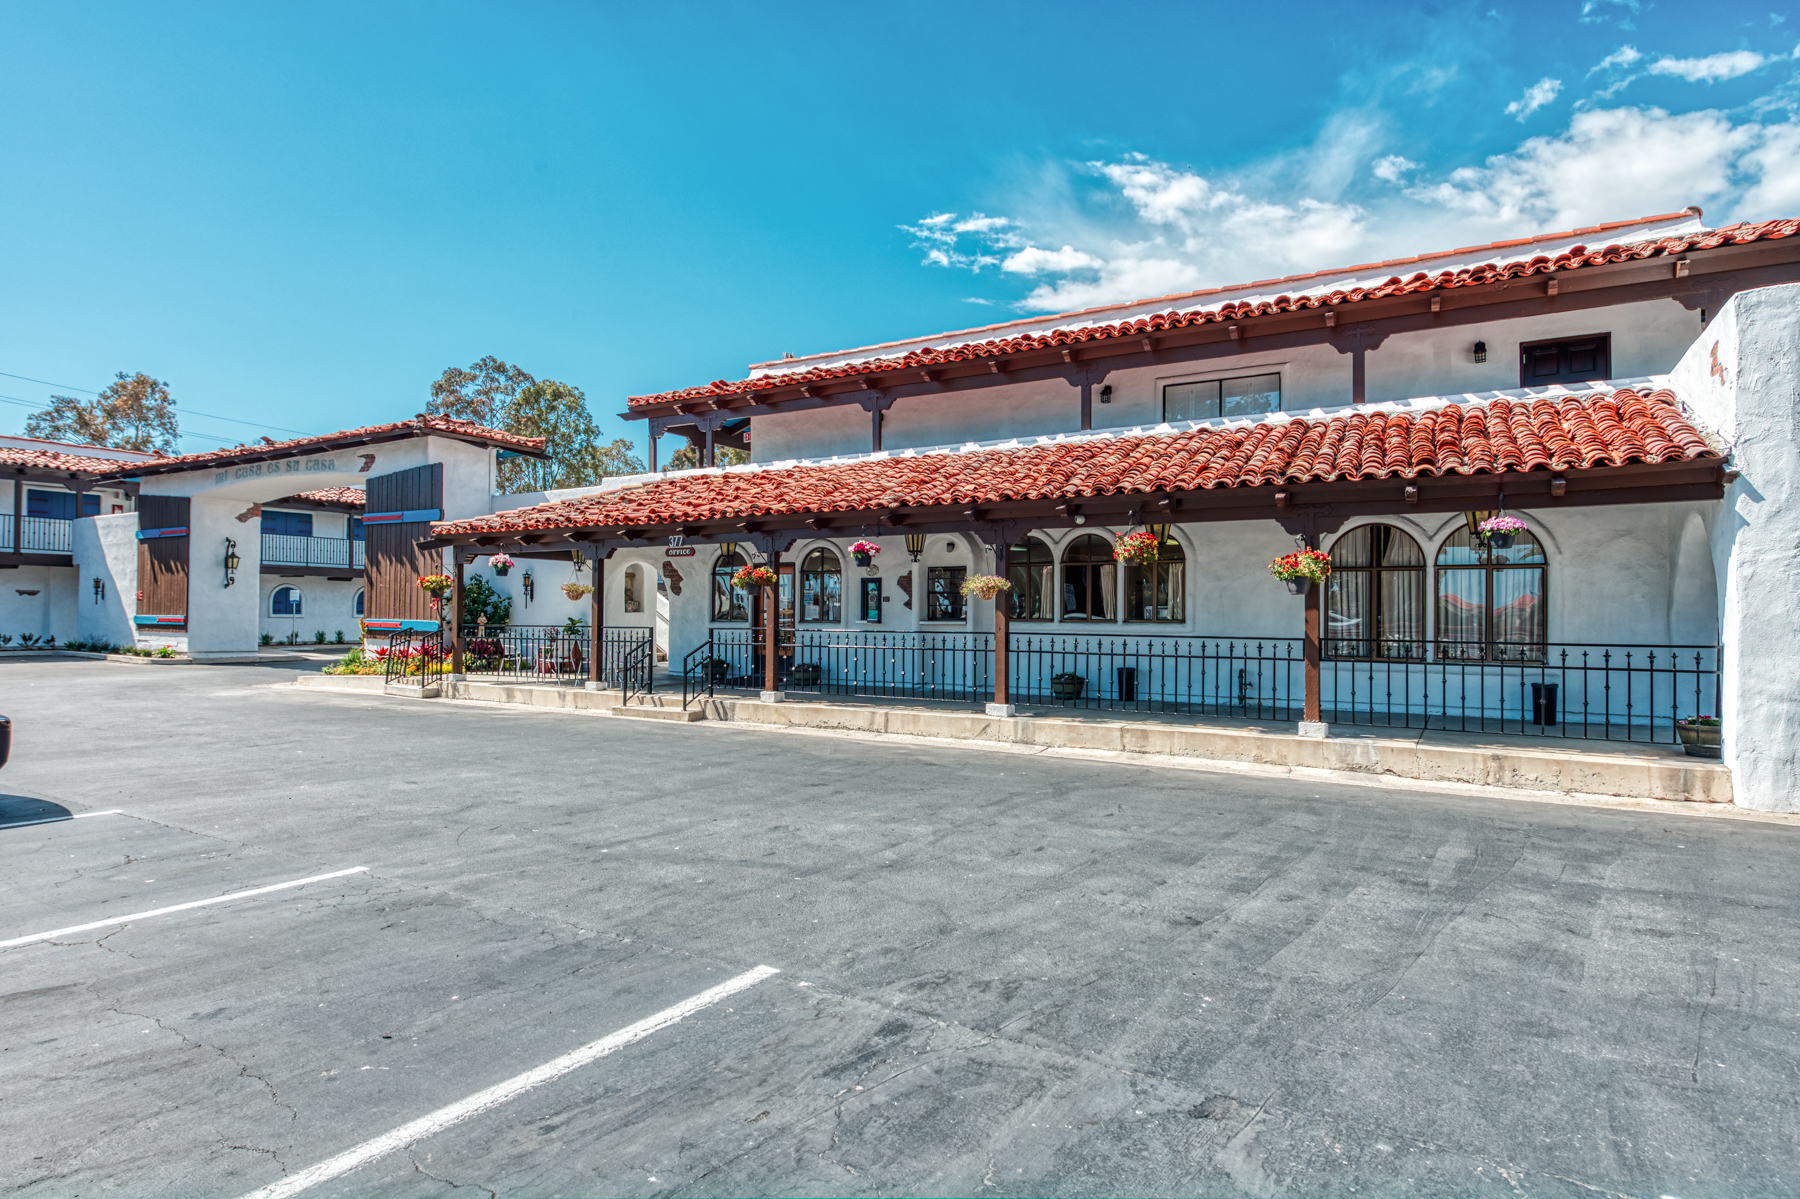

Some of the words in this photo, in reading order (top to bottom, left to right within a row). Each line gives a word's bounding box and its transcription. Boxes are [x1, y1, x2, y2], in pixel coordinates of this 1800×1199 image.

[215, 470, 228, 484] mi
[235, 464, 262, 479] casa
[267, 461, 280, 473] es
[286, 460, 300, 472] su
[305, 458, 335, 471] casa
[668, 535, 683, 547] 377
